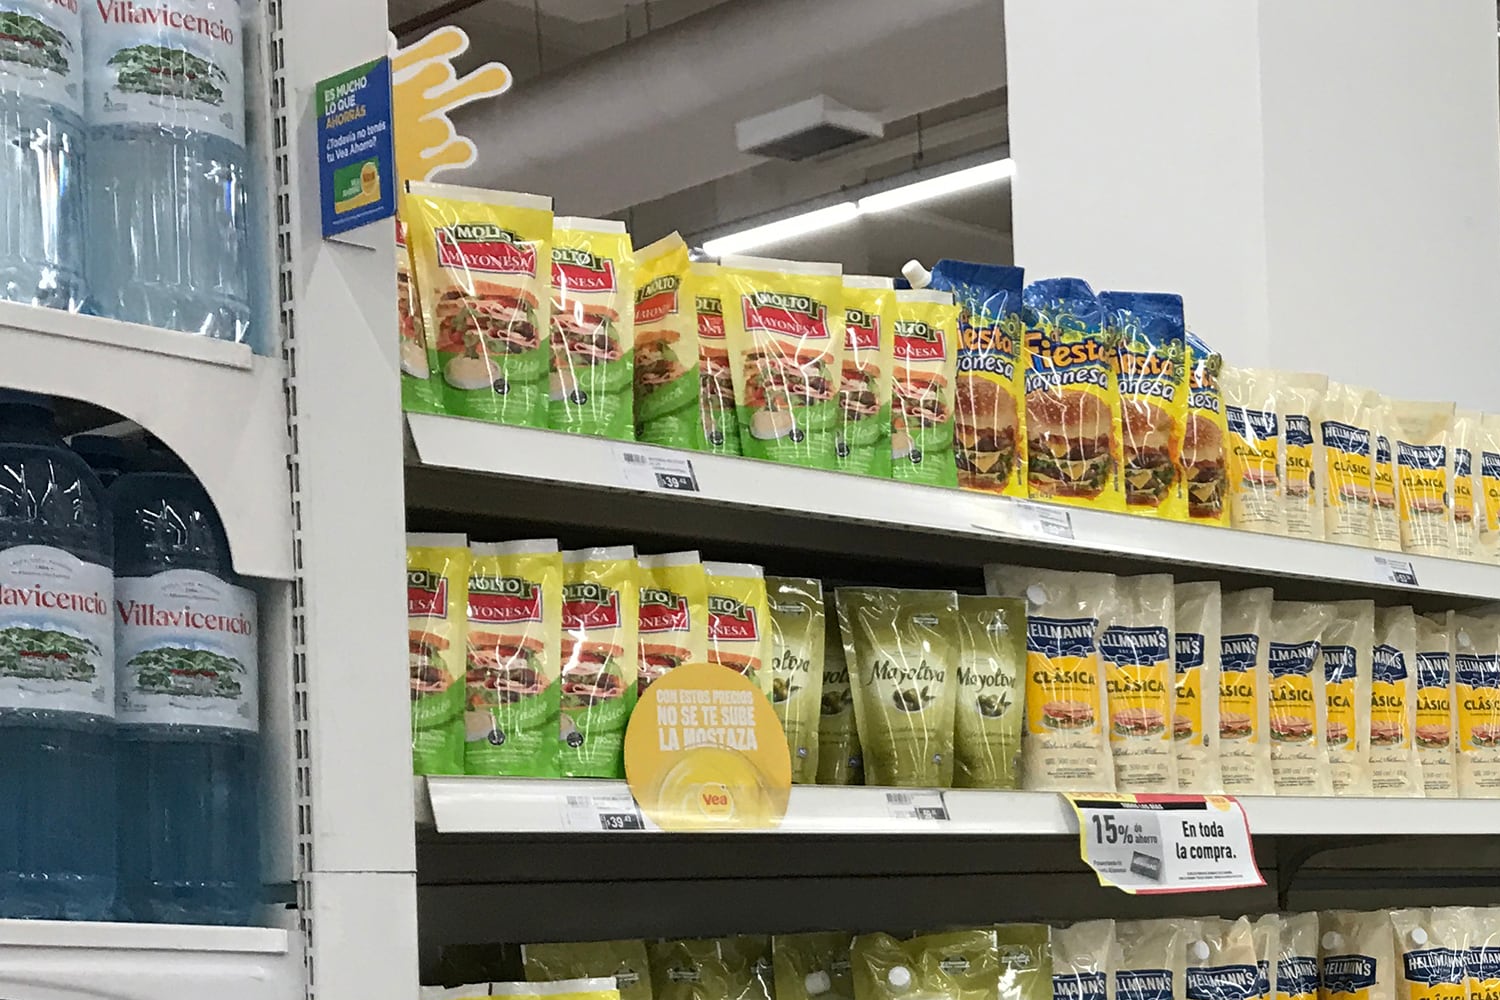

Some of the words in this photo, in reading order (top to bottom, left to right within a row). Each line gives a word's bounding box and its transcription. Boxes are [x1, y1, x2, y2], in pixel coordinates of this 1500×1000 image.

[97, 0, 234, 44] Villavicencio
[324, 89, 335, 102] ES
[337, 76, 368, 95] MUCHO
[325, 102, 336, 116] LO
[338, 95, 356, 112] QUE
[552, 250, 591, 265] OLTO
[751, 313, 819, 336] MAYONESA
[957, 325, 1012, 354] iesta
[1112, 350, 1174, 376] iesta
[1119, 380, 1175, 401] onesa
[563, 584, 598, 597] OLTO
[117, 599, 251, 636] Villavicencio
[472, 604, 531, 617] YONESA
[656, 690, 675, 703] CON
[680, 690, 709, 703] ESTOS
[713, 690, 753, 704] PRECIOS
[658, 706, 677, 726] NO
[682, 707, 698, 726] SE
[702, 707, 718, 726] TE
[721, 706, 756, 726] SUBE
[659, 728, 680, 751] LA
[683, 728, 757, 751] MOSTAZA
[1092, 815, 1133, 844] 15%
[1135, 834, 1158, 844] ahorro
[1182, 821, 1196, 838] En
[1199, 823, 1224, 838] toda
[1176, 843, 1187, 859] la
[1190, 845, 1237, 862] compra.
